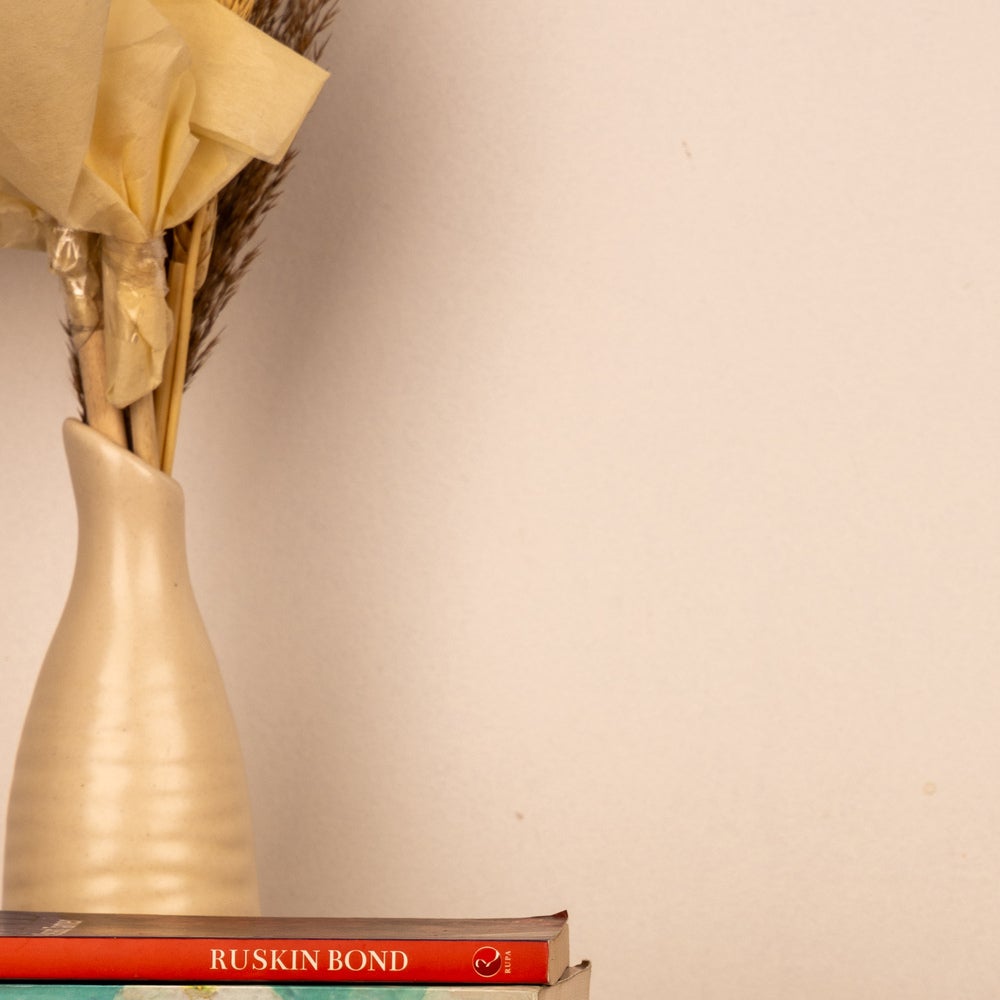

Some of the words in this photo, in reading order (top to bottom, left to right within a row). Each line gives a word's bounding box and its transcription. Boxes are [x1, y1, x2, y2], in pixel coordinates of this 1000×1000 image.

[209, 948, 320, 971] RUSKIN
[327, 949, 408, 972] BOND
[504, 950, 512, 974] RUPA
